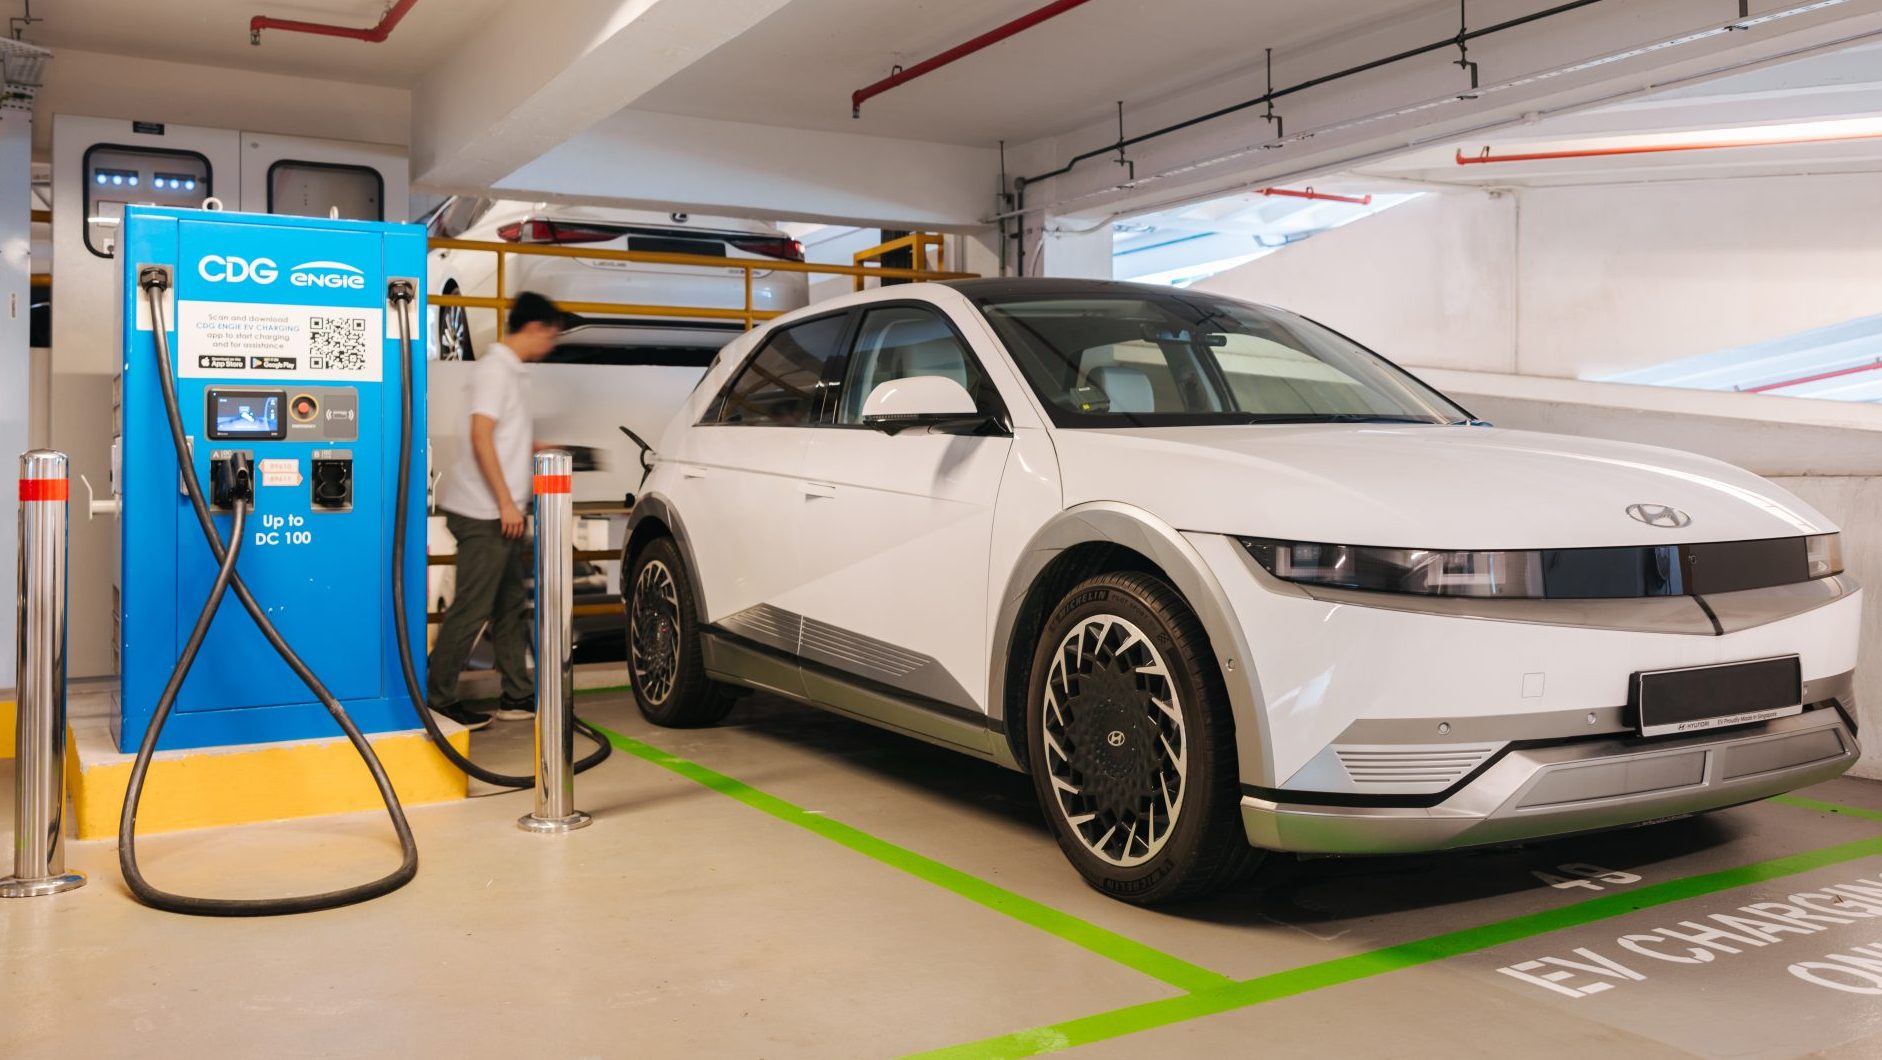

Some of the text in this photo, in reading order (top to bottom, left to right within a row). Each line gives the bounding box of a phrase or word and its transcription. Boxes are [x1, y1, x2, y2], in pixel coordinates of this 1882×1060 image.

[198, 255, 279, 285] CDG
[249, 315, 289, 323] download
[256, 324, 300, 332] CHARGING
[254, 333, 290, 341] charging
[211, 360, 244, 368] App Store
[263, 361, 283, 369] Google
[212, 450, 220, 458] A
[263, 514, 304, 529] Up to
[255, 532, 312, 545] DC 100
[1495, 875, 1882, 998] EV CHARGIN
[1787, 943, 1882, 995] ON
